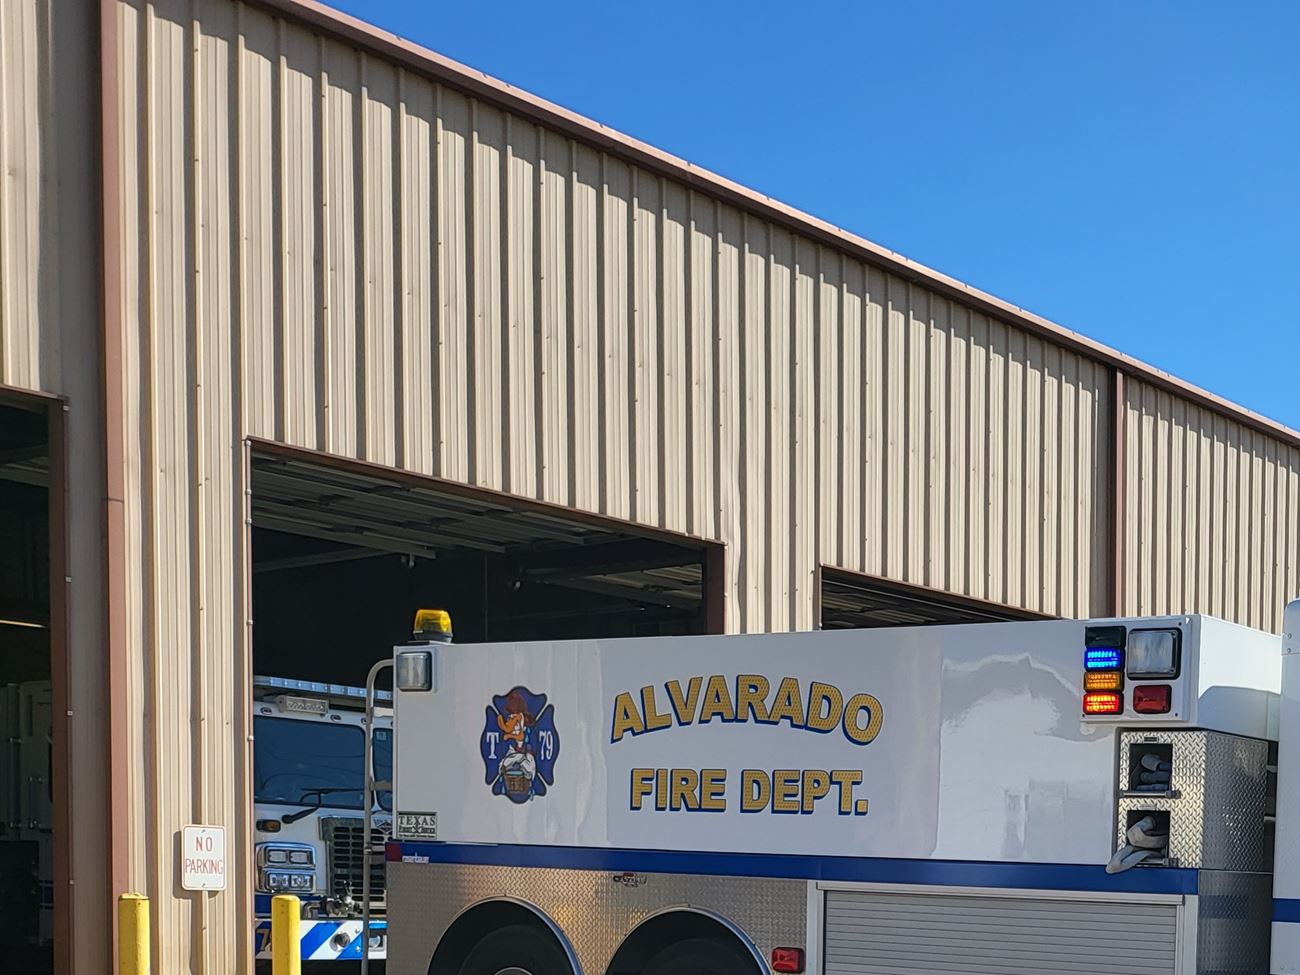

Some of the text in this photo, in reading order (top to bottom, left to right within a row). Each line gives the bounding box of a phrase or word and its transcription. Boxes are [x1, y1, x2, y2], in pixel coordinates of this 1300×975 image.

[610, 674, 884, 746] ALVARADO
[486, 730, 554, 761] T 79
[630, 768, 869, 815] FIRE DEPT.
[399, 815, 436, 826] TEXAS
[195, 836, 213, 852] NO
[185, 858, 223, 875] PARKING
